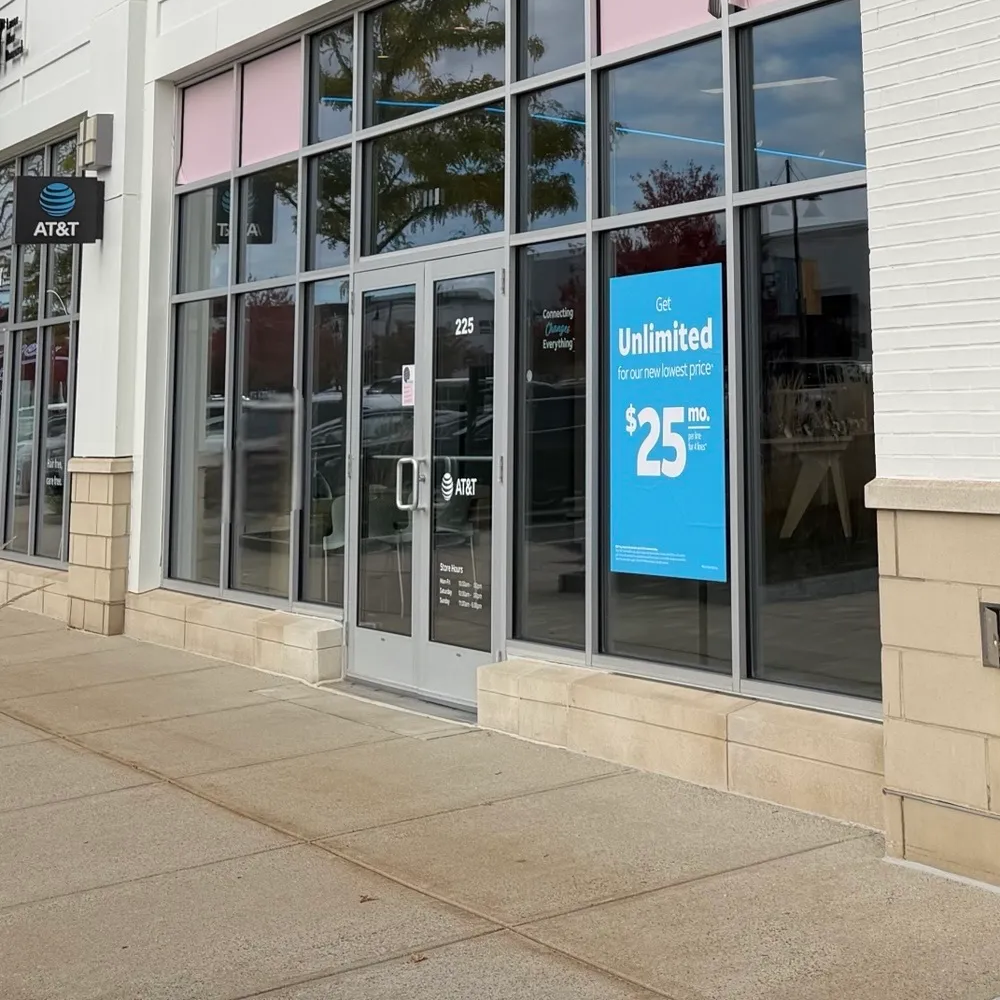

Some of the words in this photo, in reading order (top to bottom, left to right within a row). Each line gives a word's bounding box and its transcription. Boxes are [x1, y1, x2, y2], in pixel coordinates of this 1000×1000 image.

[33, 221, 80, 237] AT&T
[655, 296, 672, 312] Get
[542, 306, 574, 319] Connecting
[455, 316, 475, 336] 225
[618, 317, 713, 356] Unlimited
[617, 365, 629, 380] for
[630, 367, 643, 380] our
[644, 366, 660, 379] new
[661, 363, 688, 378] lowest
[687, 406, 710, 422] mo.
[455, 478, 477, 496] AT&T
